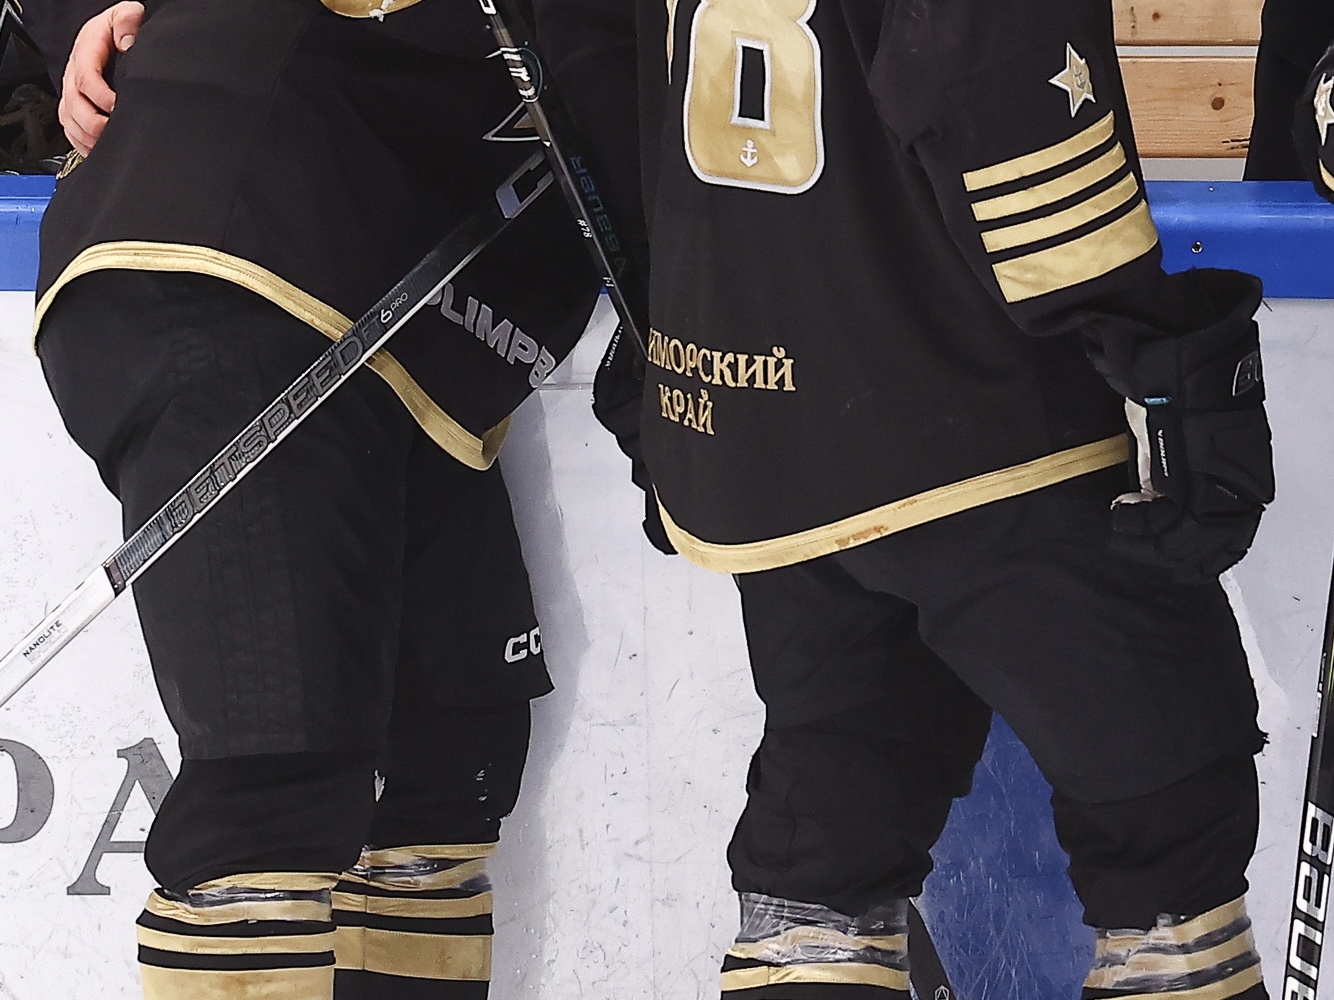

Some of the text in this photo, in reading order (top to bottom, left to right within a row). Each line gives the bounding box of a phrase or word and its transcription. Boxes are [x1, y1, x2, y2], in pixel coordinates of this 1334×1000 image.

[576, 218, 593, 239] #78
[426, 281, 557, 389] LIMPB
[172, 334, 365, 534] JETSPEED
[390, 292, 409, 312] PRO
[657, 383, 716, 436] КРАЙ
[22, 619, 63, 658] NANOLITE
[504, 626, 541, 664] CC
